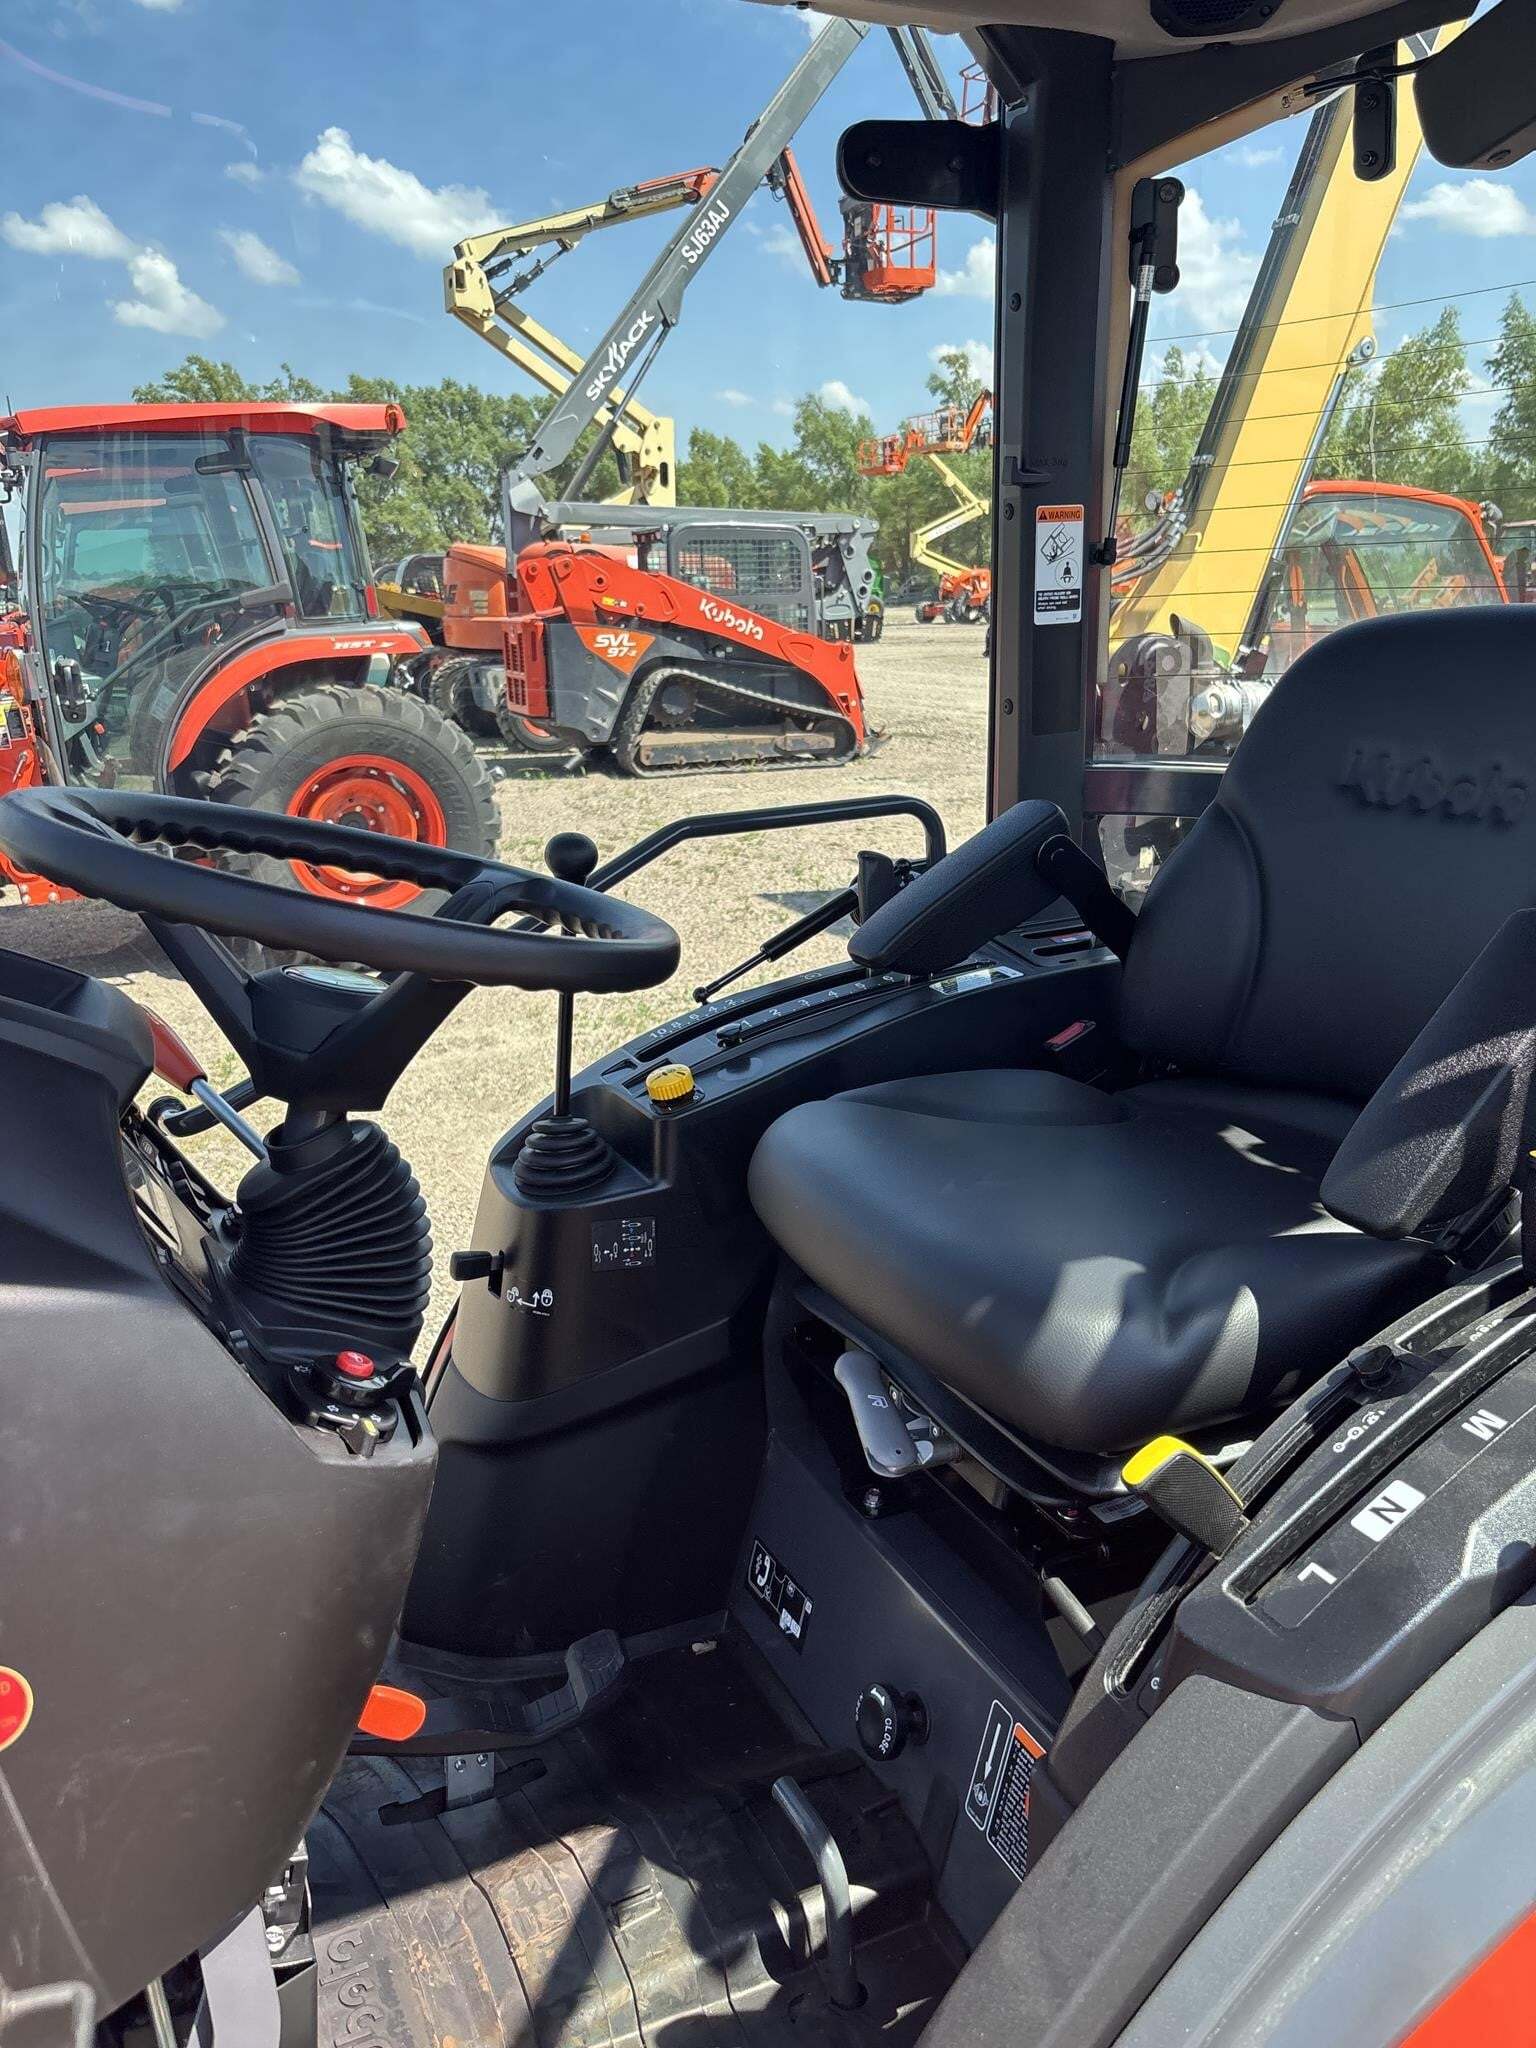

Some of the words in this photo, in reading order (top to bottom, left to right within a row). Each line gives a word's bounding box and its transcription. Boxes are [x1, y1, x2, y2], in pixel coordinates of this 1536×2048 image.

[681, 200, 730, 264] SJ63AJ
[586, 310, 655, 401] SKYJACK
[1048, 510, 1081, 520] WARNING
[699, 598, 764, 641] Kubota
[594, 633, 637, 648] SVL
[1461, 1408, 1508, 1441] M
[1369, 1495, 1407, 1524] N
[1297, 1561, 1337, 1585] L
[878, 1717, 893, 1754] CLOSE
